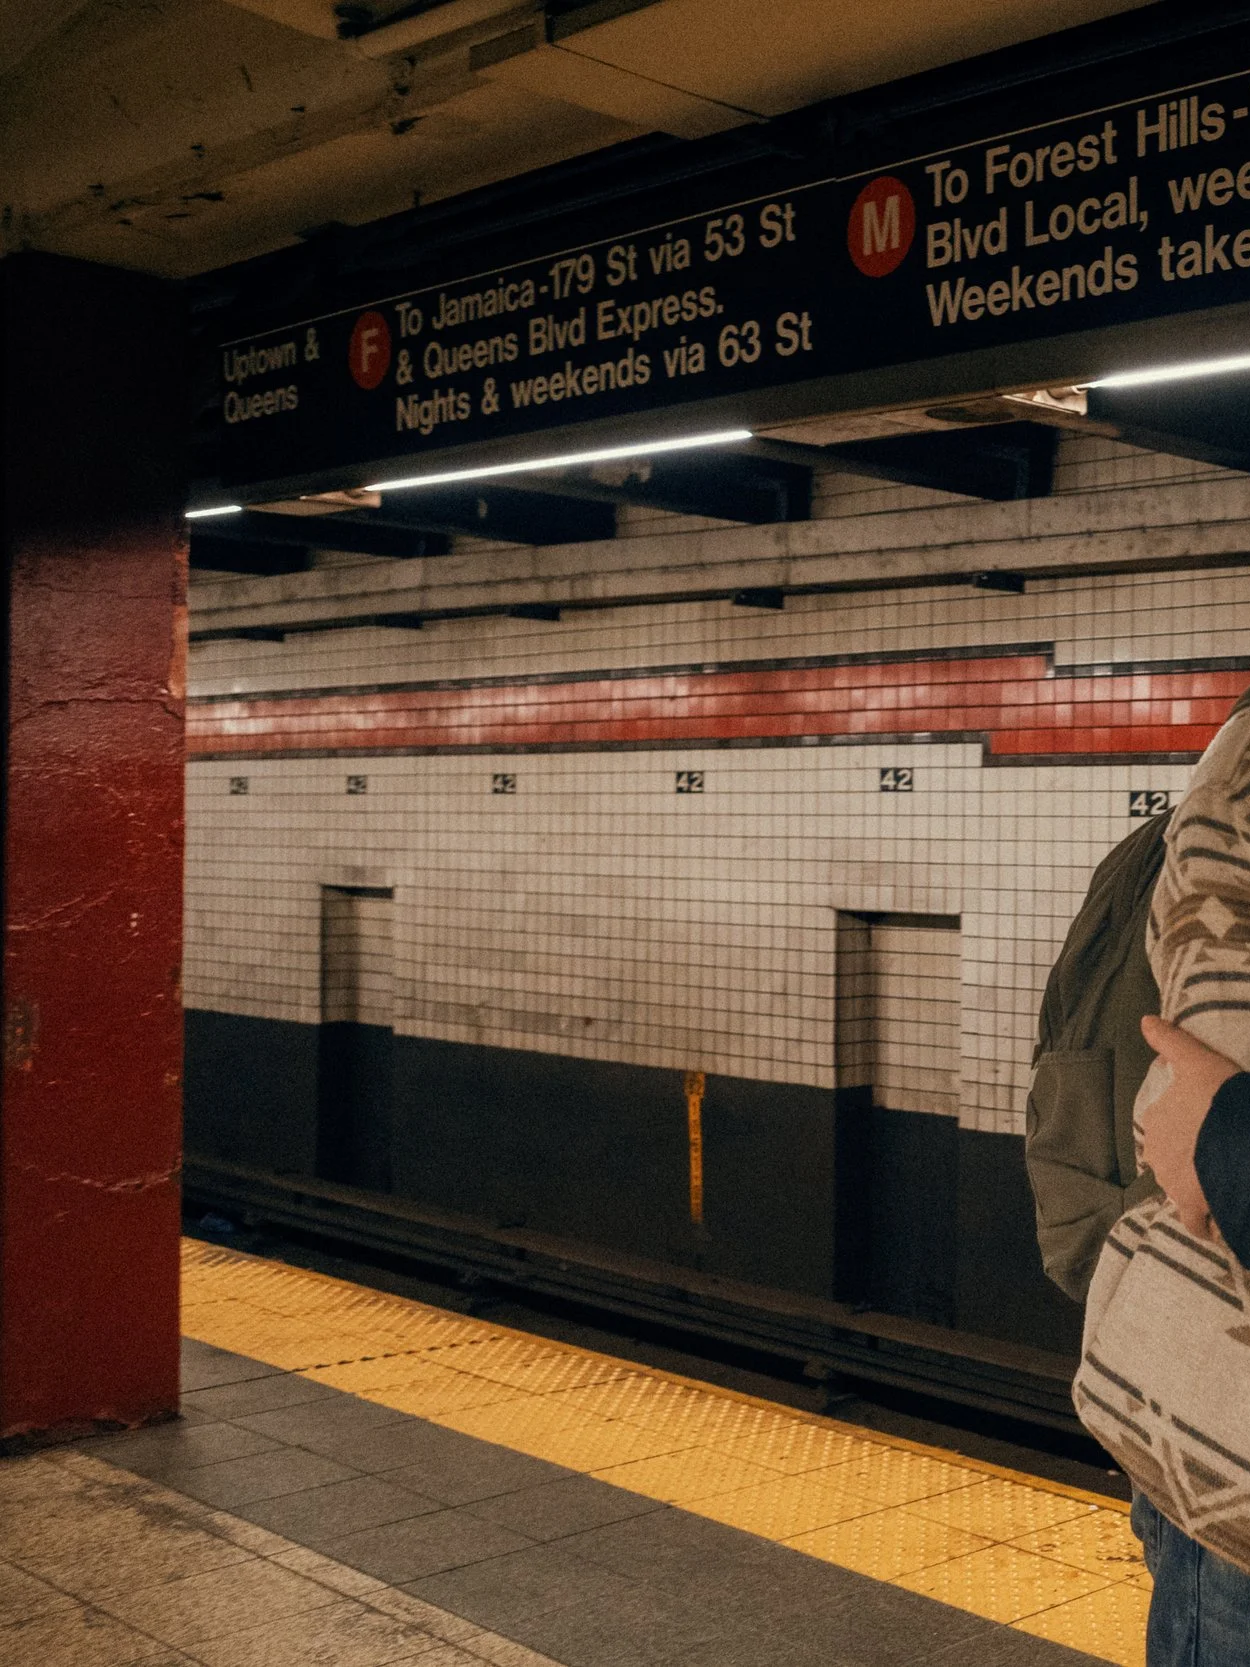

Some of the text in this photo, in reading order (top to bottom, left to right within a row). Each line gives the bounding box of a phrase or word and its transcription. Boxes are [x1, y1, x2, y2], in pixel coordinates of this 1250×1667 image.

[926, 160, 969, 207] To
[985, 121, 1118, 194] Forest
[861, 194, 901, 257] M
[926, 207, 1008, 269] Blvd
[1026, 176, 1149, 247] Local,
[394, 202, 796, 337] To Jamaica-179 St via 53 St
[926, 246, 1139, 327] Weekends
[223, 327, 320, 386] Uptown &
[360, 327, 379, 373] F
[396, 286, 725, 386] & Queens Blvd Express.
[223, 384, 298, 424] Queens
[396, 311, 813, 436] Nights & weekends via 63 St
[675, 772, 703, 792] 42
[881, 769, 913, 790] 42
[1130, 791, 1168, 815] 42
